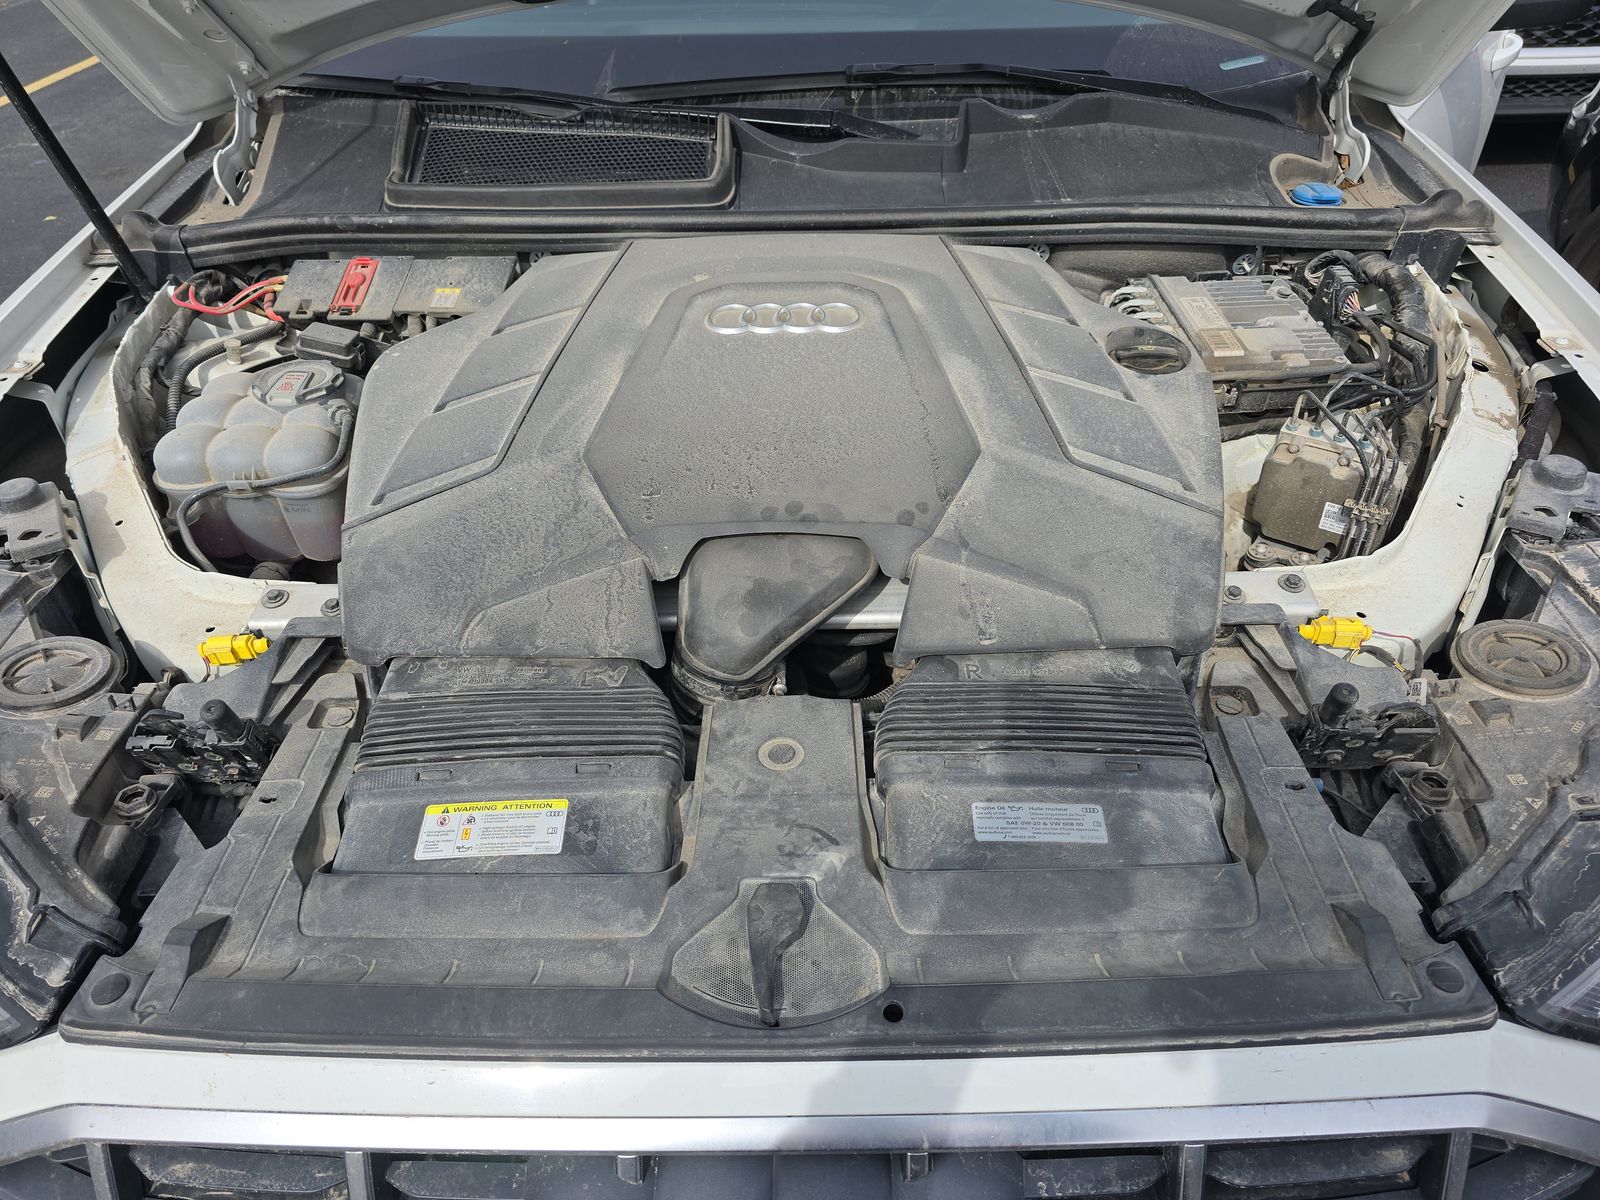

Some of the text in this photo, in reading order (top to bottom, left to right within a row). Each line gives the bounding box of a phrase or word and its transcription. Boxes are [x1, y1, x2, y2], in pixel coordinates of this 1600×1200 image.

[964, 664, 983, 680] R
[453, 802, 553, 813] WARNING ATTENTION
